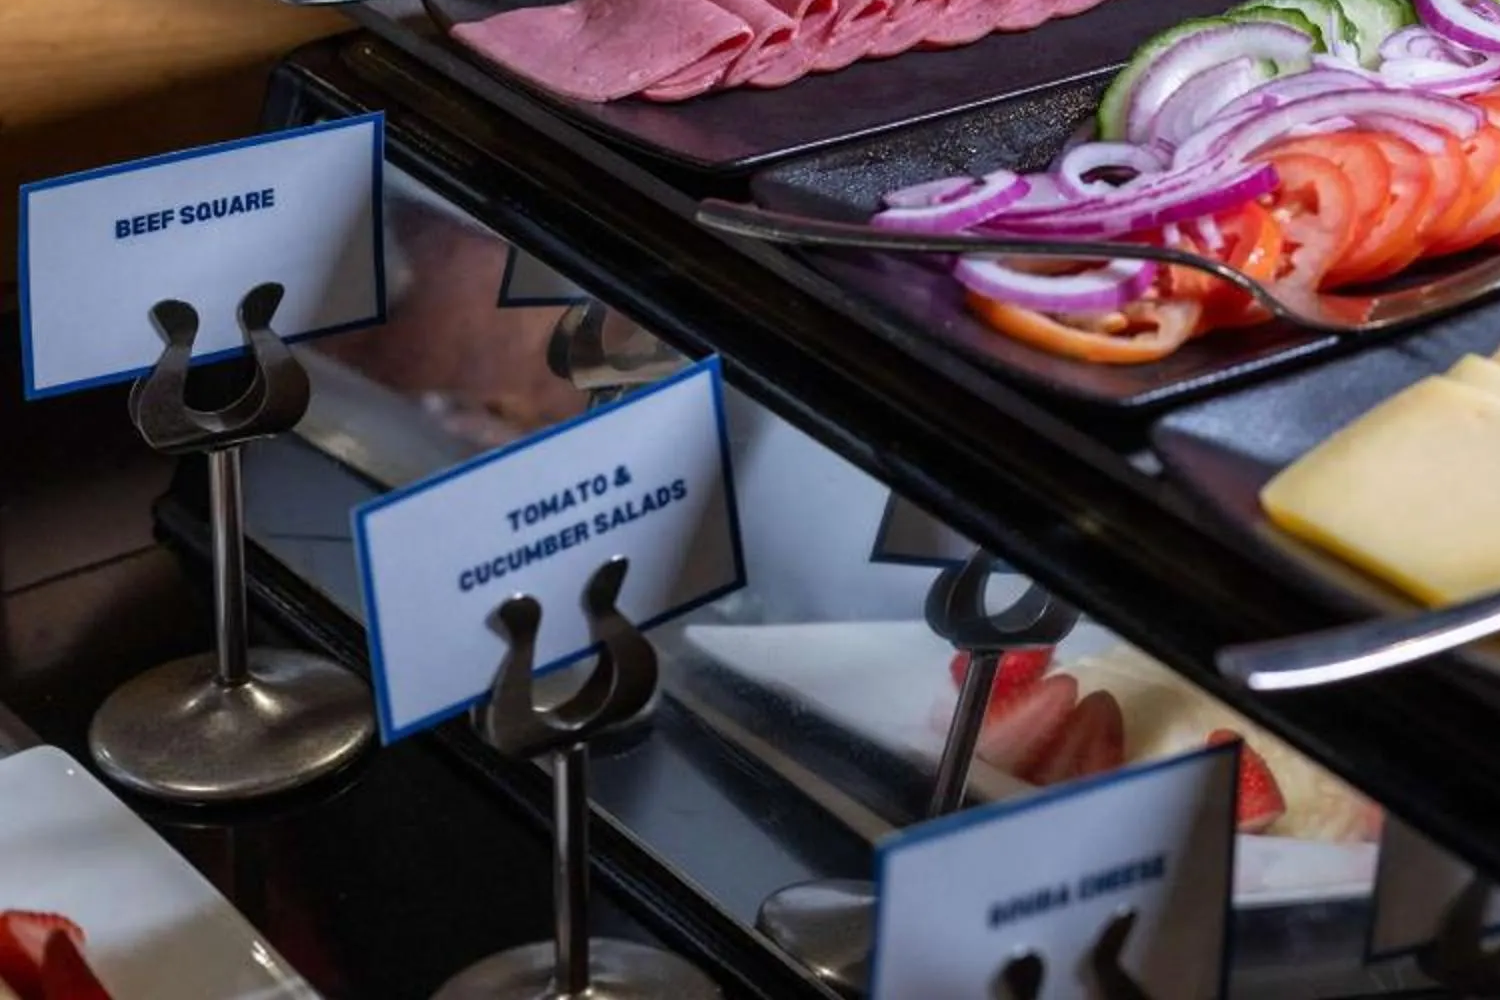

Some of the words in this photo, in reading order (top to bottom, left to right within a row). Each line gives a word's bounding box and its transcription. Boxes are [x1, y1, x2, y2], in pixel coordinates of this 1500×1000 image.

[115, 208, 174, 239] BEEF
[180, 188, 275, 225] SQUARE
[506, 473, 607, 532] TOMATO
[613, 464, 632, 487] &
[458, 521, 591, 593] CUCUMBER
[594, 478, 688, 536] SALADS
[1078, 855, 1165, 899] CHEESE
